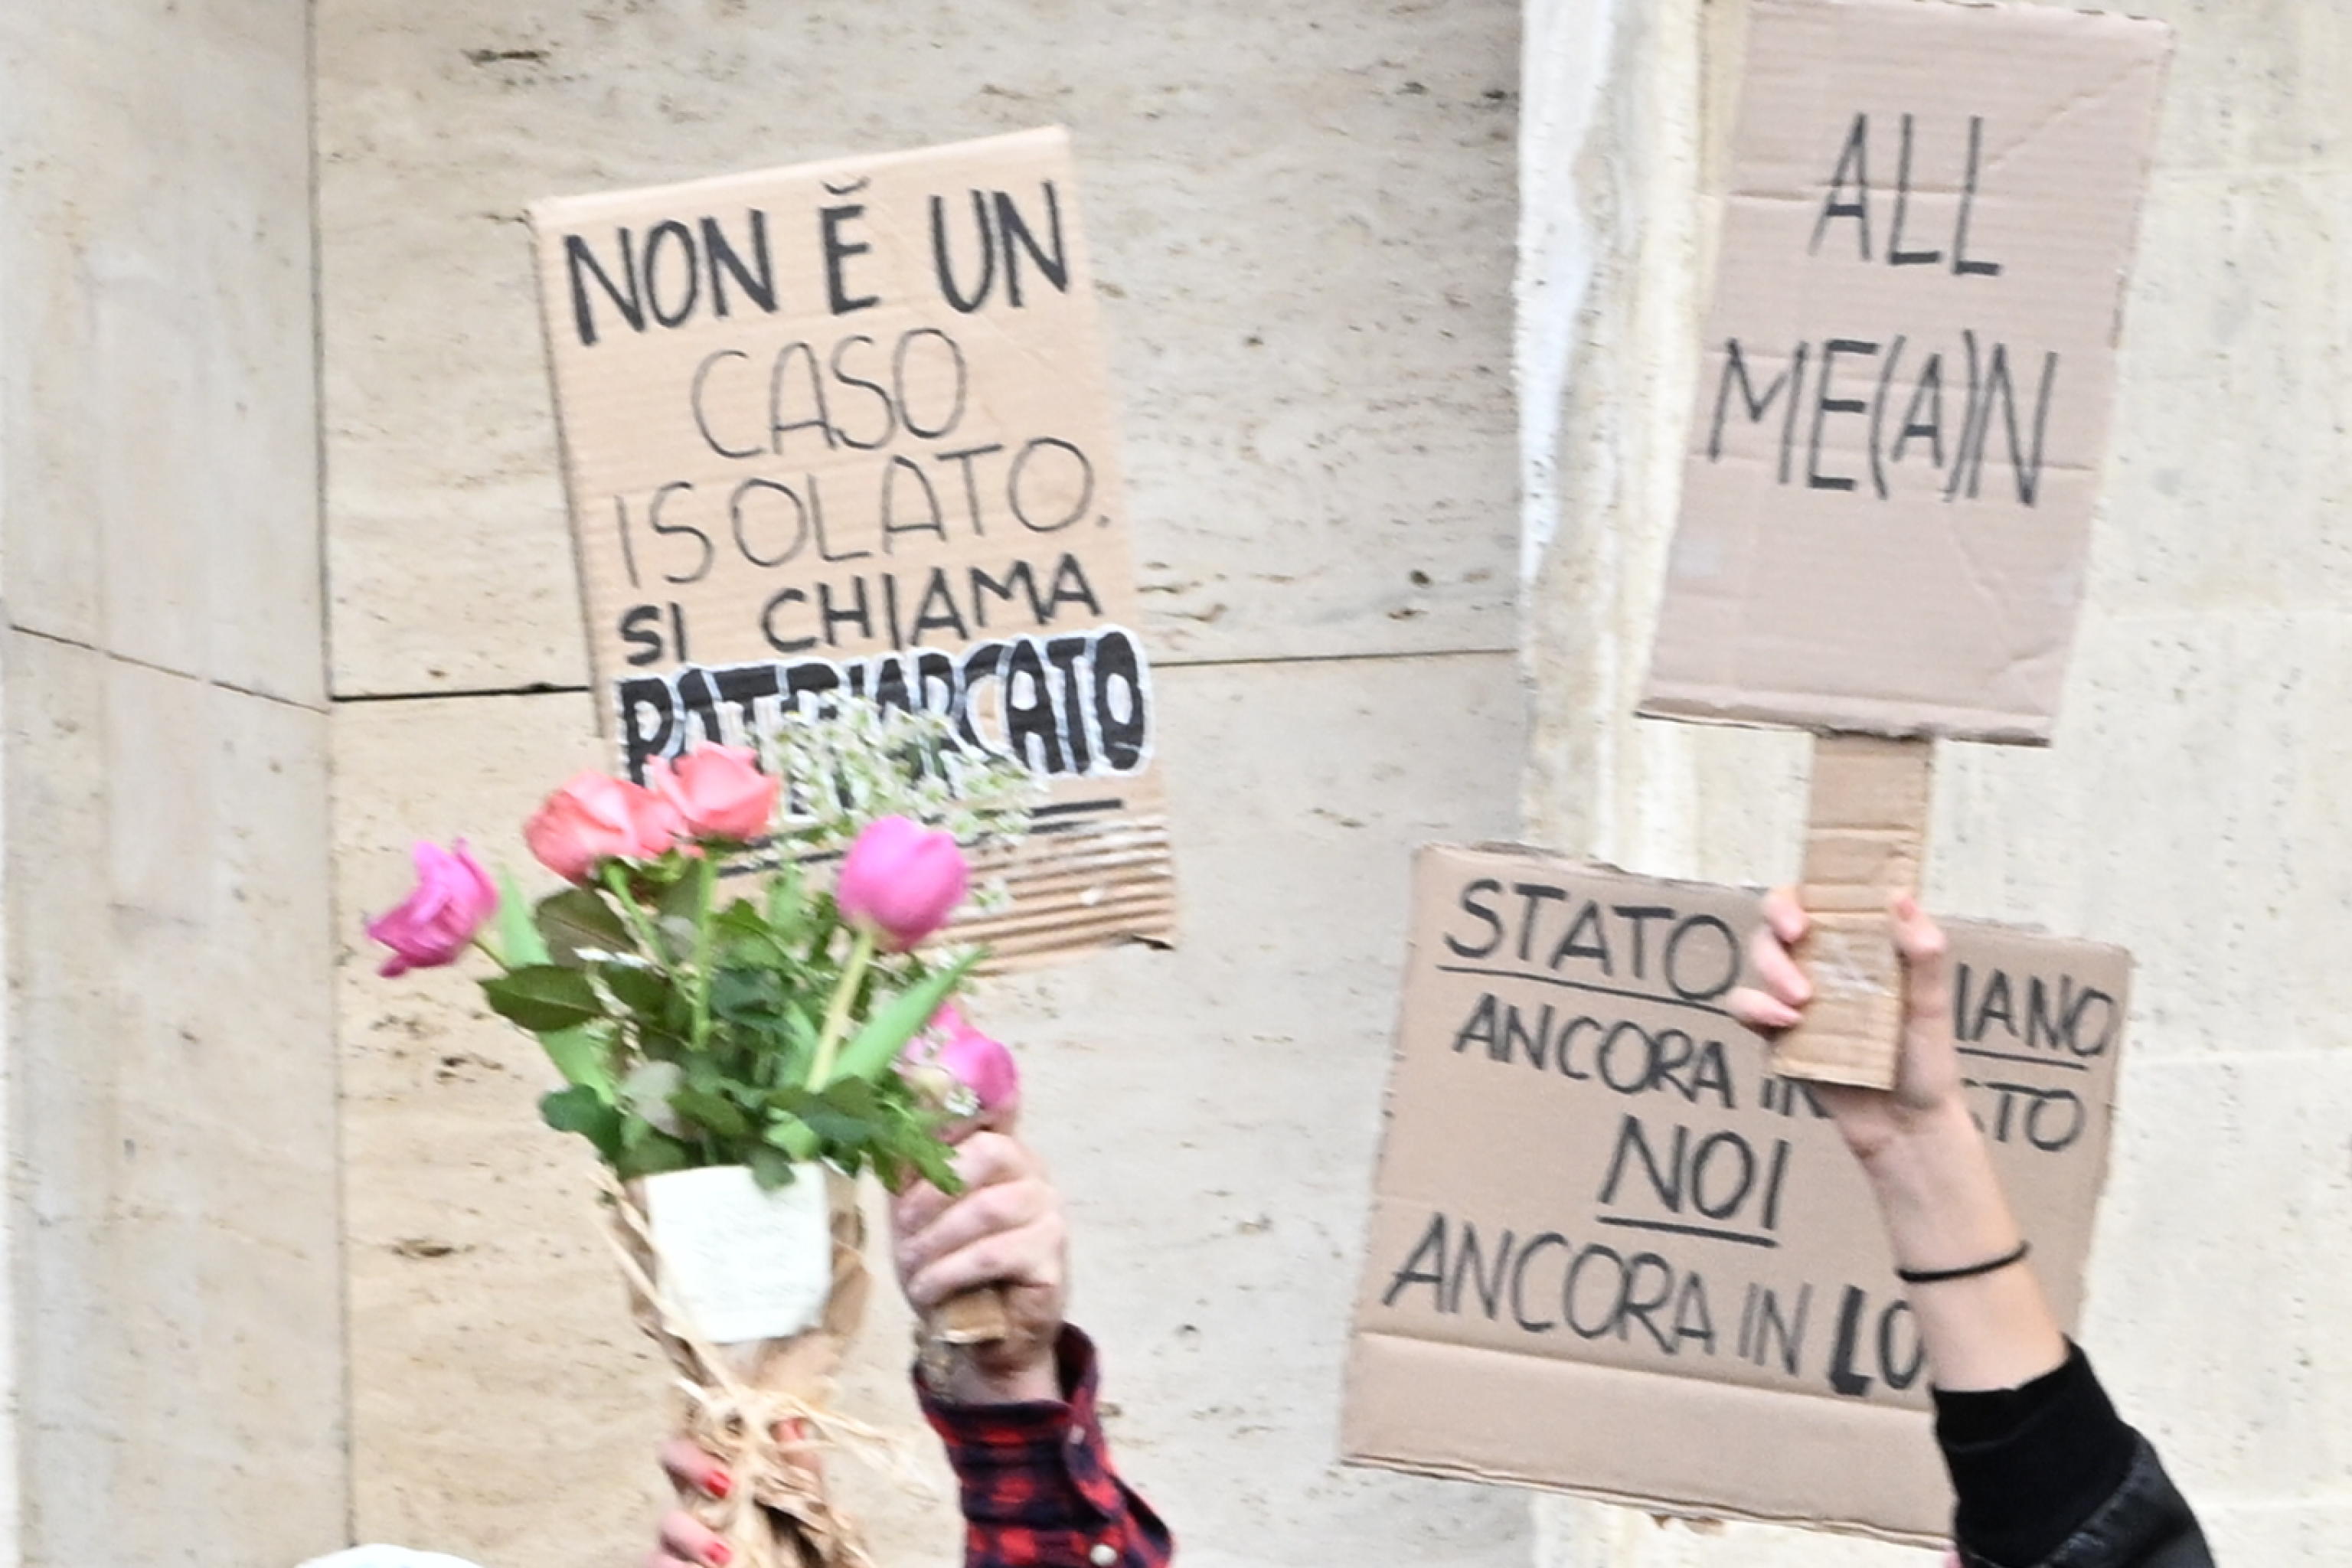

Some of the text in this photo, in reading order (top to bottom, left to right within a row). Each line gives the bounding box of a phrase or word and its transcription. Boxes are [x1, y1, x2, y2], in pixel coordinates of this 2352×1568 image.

[563, 207, 777, 346] NON
[929, 179, 1069, 314] UN
[1808, 112, 2001, 276] ALL
[691, 327, 968, 459] CASO
[1708, 328, 2060, 507] ME(A)N
[614, 436, 1112, 588] ISOLATO.
[619, 553, 1101, 666] SI CHIAMA
[1443, 877, 2115, 1057] STATO IANO
[1452, 993, 1736, 1110] ANCORA
[1599, 1113, 1790, 1230] NOI
[1382, 1213, 1717, 1355] ANCORA
[1736, 1282, 1813, 1375] IN
